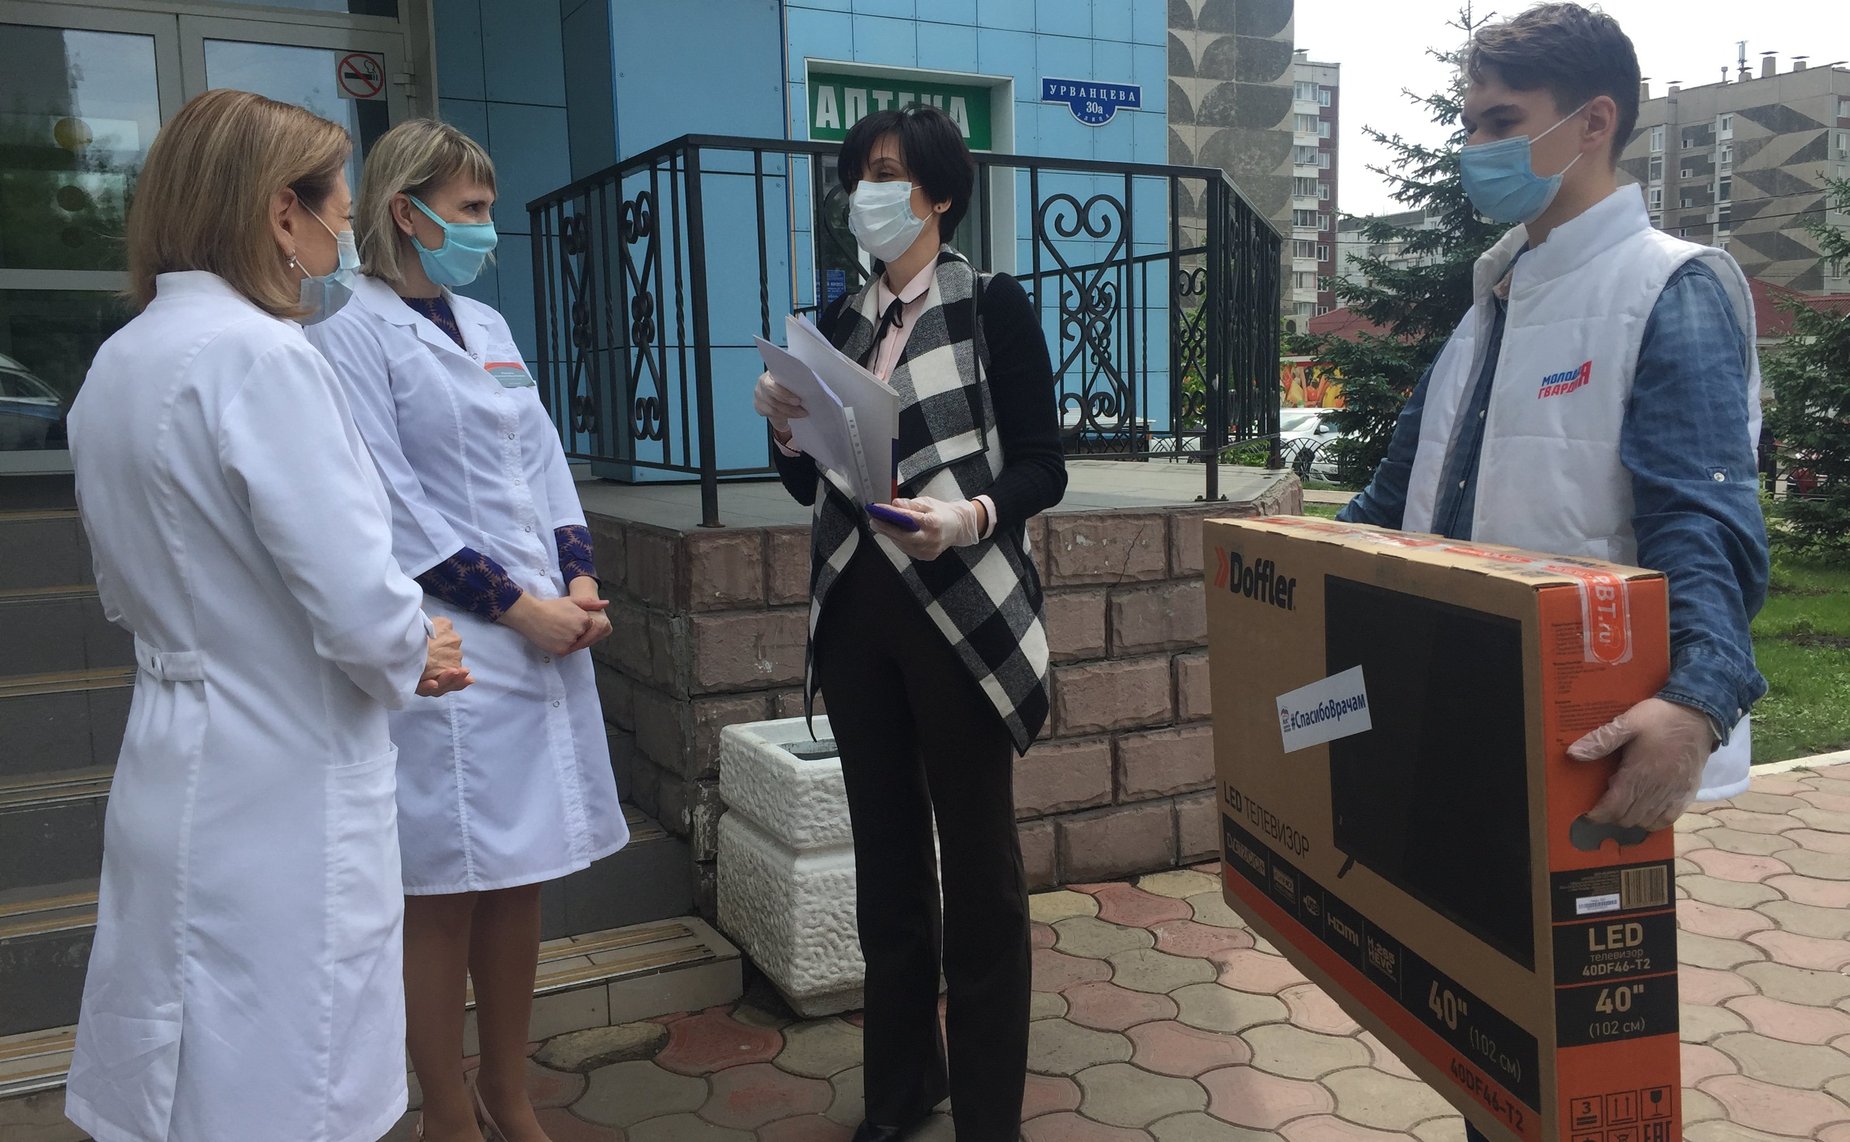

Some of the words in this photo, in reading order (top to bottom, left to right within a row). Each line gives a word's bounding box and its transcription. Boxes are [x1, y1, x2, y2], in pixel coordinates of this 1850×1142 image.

[1049, 84, 1136, 102] УРВАНЦЕВА
[1086, 101, 1103, 114] 30а
[1230, 551, 1296, 611] Doffler
[1290, 693, 1366, 731] #СпасибоВрачам
[1224, 780, 1243, 813] LED
[1244, 795, 1310, 860] ТЕЛЕВИЗОР
[1588, 922, 1643, 951] LED
[1582, 959, 1651, 976] 40DF46-T2
[1590, 948, 1644, 962] телевизор
[1595, 984, 1645, 1014] 40"
[1428, 980, 1467, 1031] 40"
[1469, 1025, 1497, 1064] (102
[1589, 1020, 1620, 1039] (102
[1450, 1056, 1524, 1134] 40DF46-T2
[1582, 1101, 1591, 1114] 3
